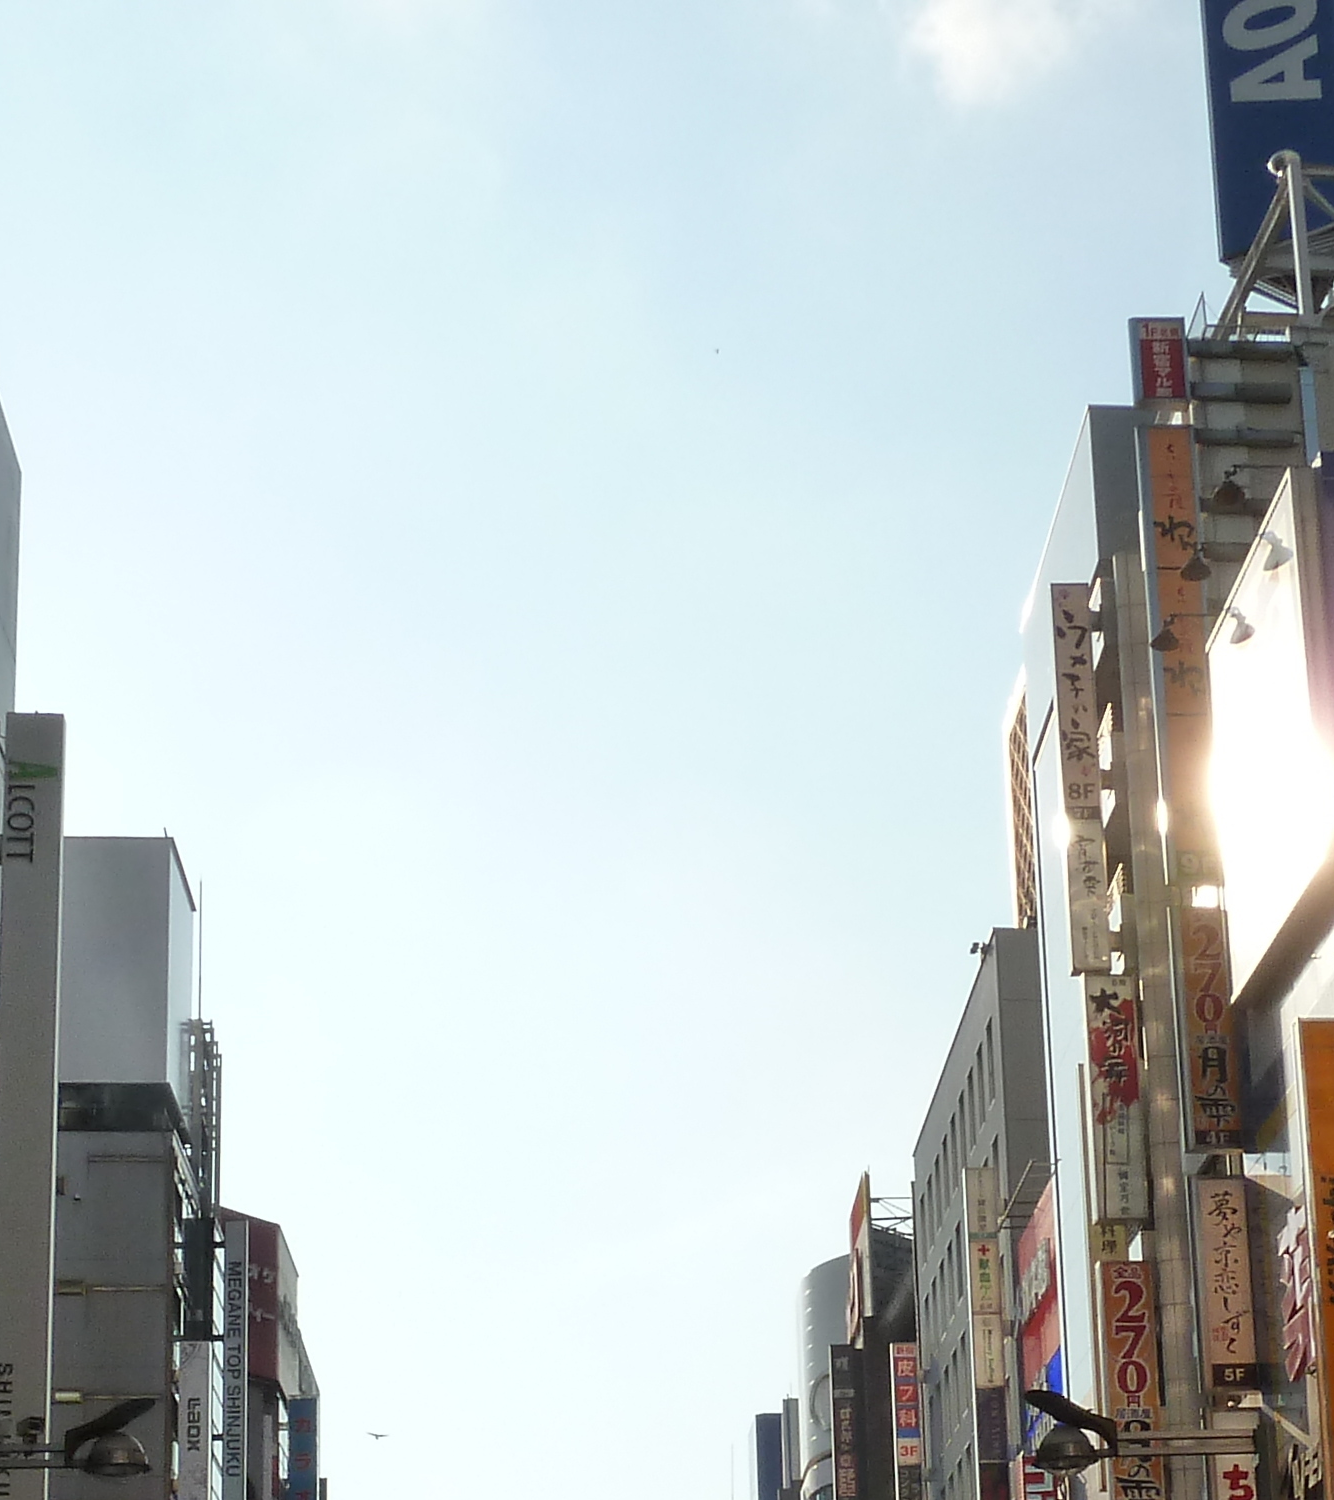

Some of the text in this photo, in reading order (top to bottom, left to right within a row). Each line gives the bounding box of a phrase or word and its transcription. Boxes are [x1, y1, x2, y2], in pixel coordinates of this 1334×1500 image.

[1068, 784, 1095, 800] 8F
[224, 1260, 243, 1478] MEGANE TOP SHINJUKU
[1223, 1371, 1246, 1384] 5F
[896, 1359, 917, 1428] 皮フ科
[899, 1445, 919, 1457] 3F
